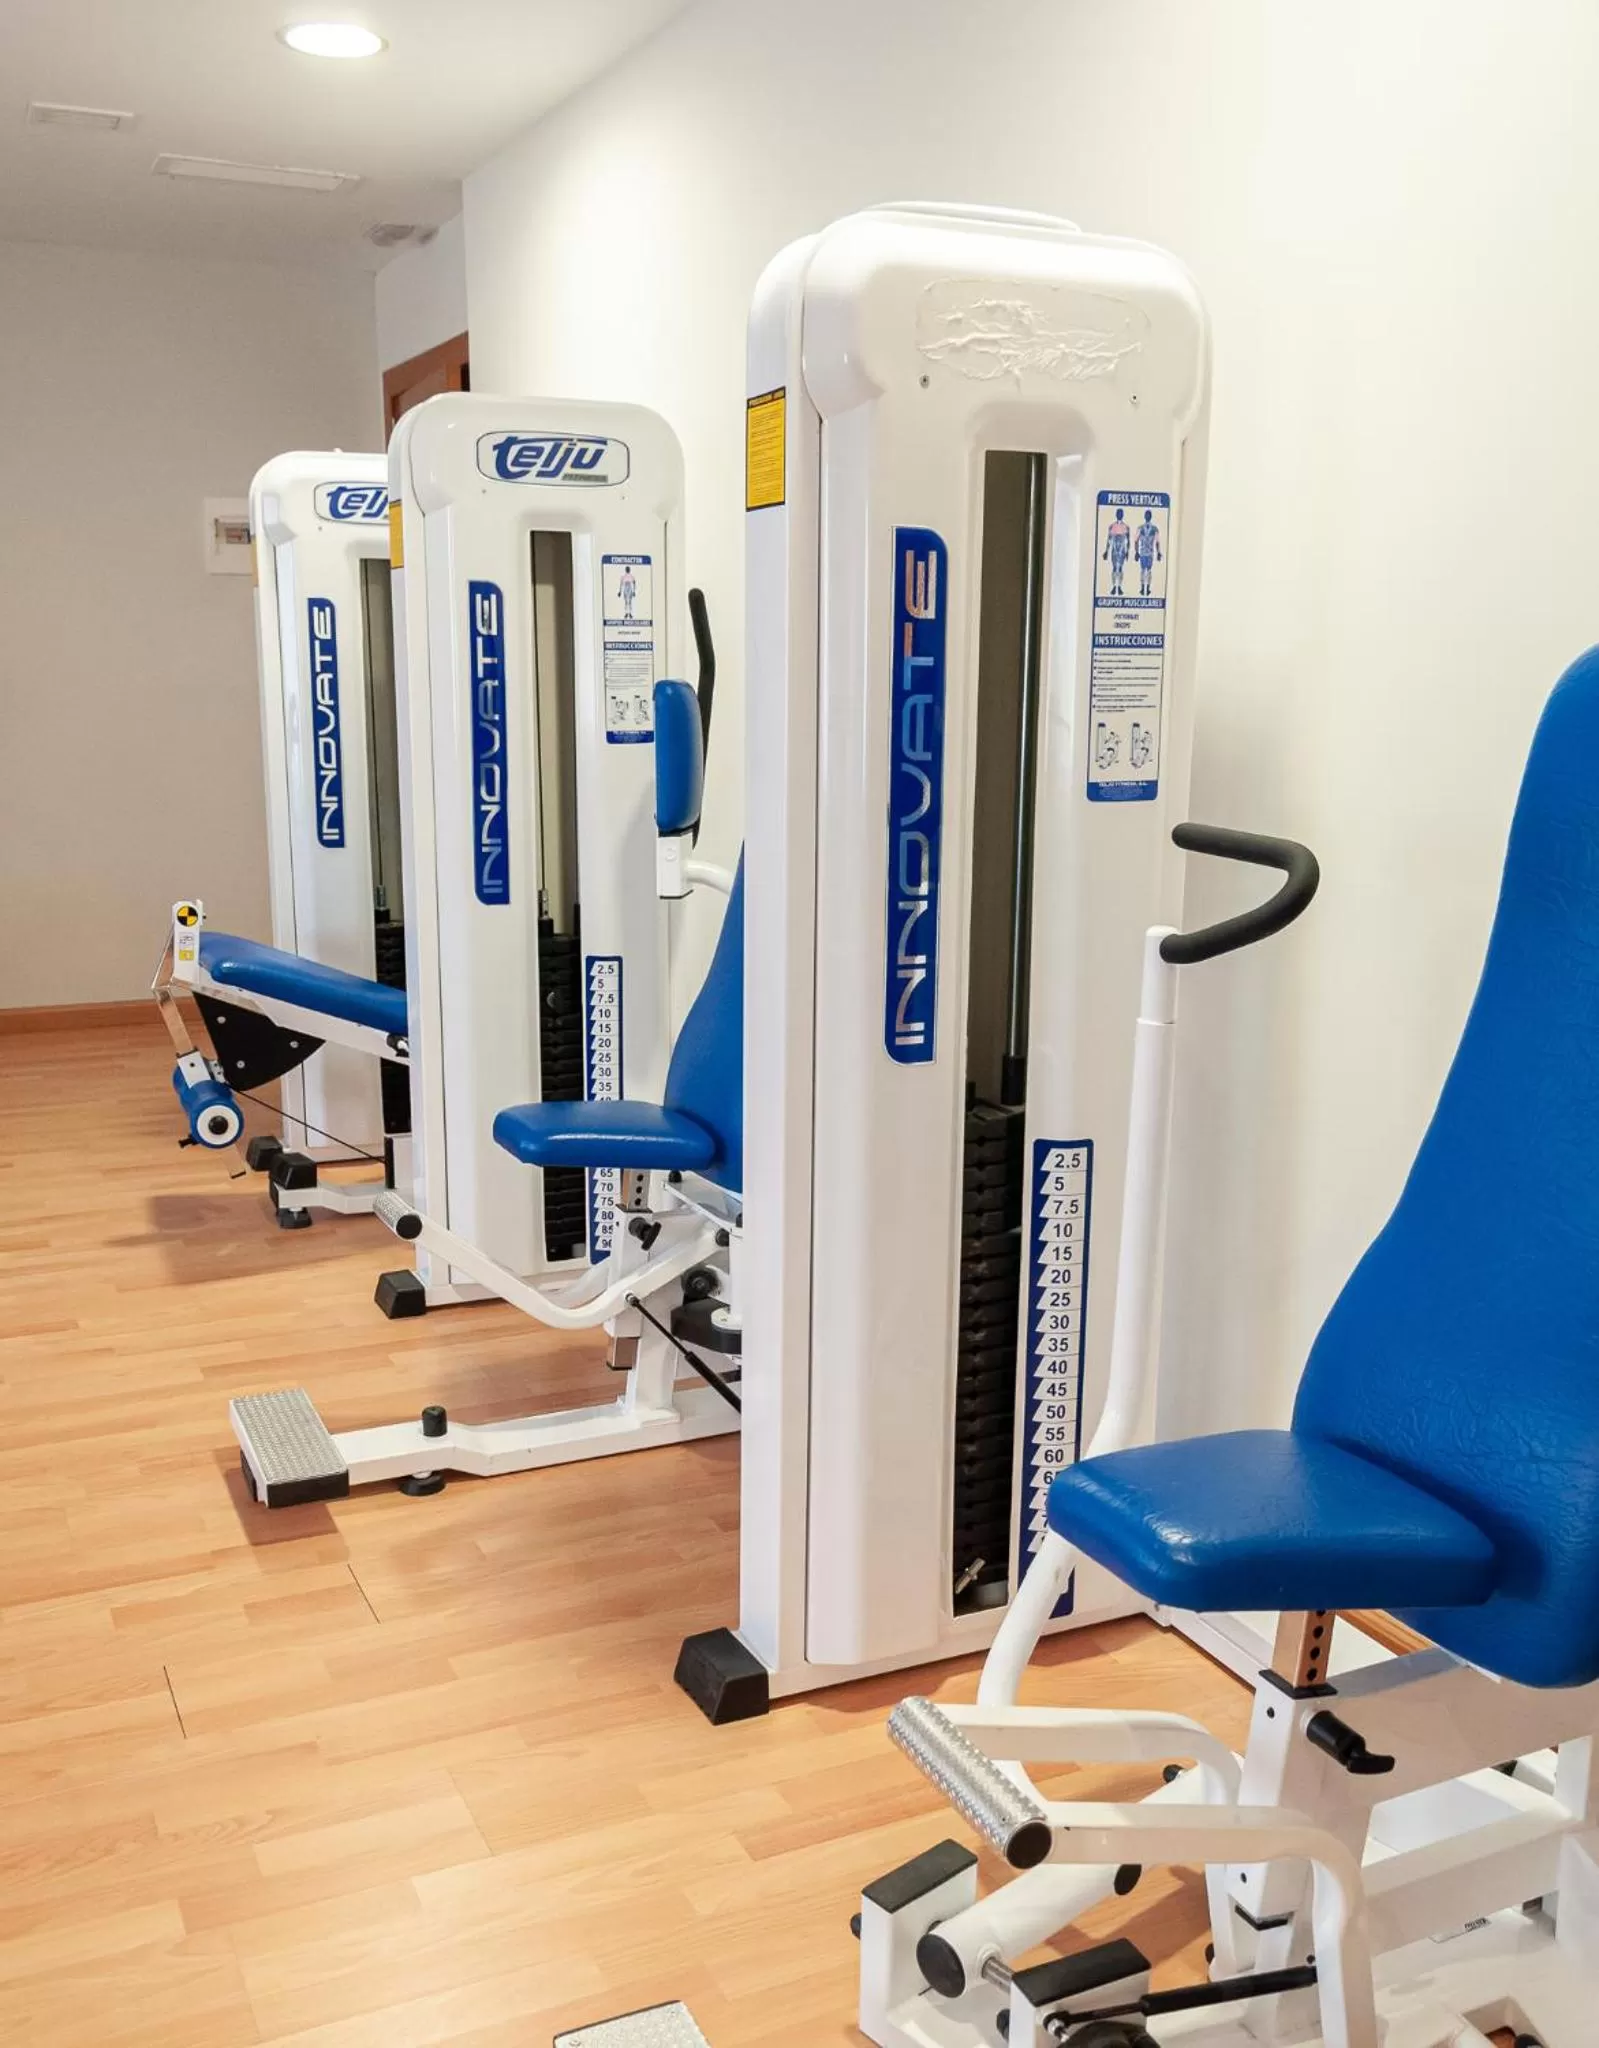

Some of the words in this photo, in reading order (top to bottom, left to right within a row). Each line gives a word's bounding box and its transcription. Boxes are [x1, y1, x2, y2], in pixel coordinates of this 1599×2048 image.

[492, 436, 608, 480] telju
[327, 485, 389, 519] telj
[1108, 493, 1129, 505] PRESS
[1131, 494, 1163, 506] VERTICAL
[1095, 635, 1163, 646] INSTRUCCIONES
[312, 606, 340, 840] INNOVATE
[475, 593, 503, 894] INNOVATE
[895, 550, 938, 1045] INNOVATE
[597, 964, 614, 974] 2.5
[597, 979, 604, 989] 5
[597, 994, 614, 1003] 7.5
[598, 1009, 611, 1018] 10
[598, 1024, 611, 1033] 15
[598, 1038, 611, 1048] 20
[598, 1053, 611, 1062] 25
[598, 1067, 611, 1077] 30
[598, 1082, 612, 1091] 35
[1054, 1153, 1081, 1169] 2.5
[600, 1168, 614, 1178] 65
[601, 1182, 614, 1192] 70
[1054, 1177, 1065, 1192] 5
[601, 1197, 614, 1206] 75
[1053, 1200, 1079, 1215] 7.5
[601, 1211, 614, 1220] 80
[1053, 1223, 1073, 1238] 10
[1052, 1246, 1073, 1261] 15
[1051, 1269, 1071, 1284] 20
[1049, 1292, 1071, 1307] 25
[1049, 1315, 1070, 1330] 30
[1048, 1337, 1069, 1352] 35
[1047, 1360, 1068, 1375] 40
[1046, 1382, 1067, 1397] 45
[1046, 1405, 1066, 1419] 50
[1045, 1427, 1065, 1441] 55
[1044, 1449, 1064, 1463] 60
